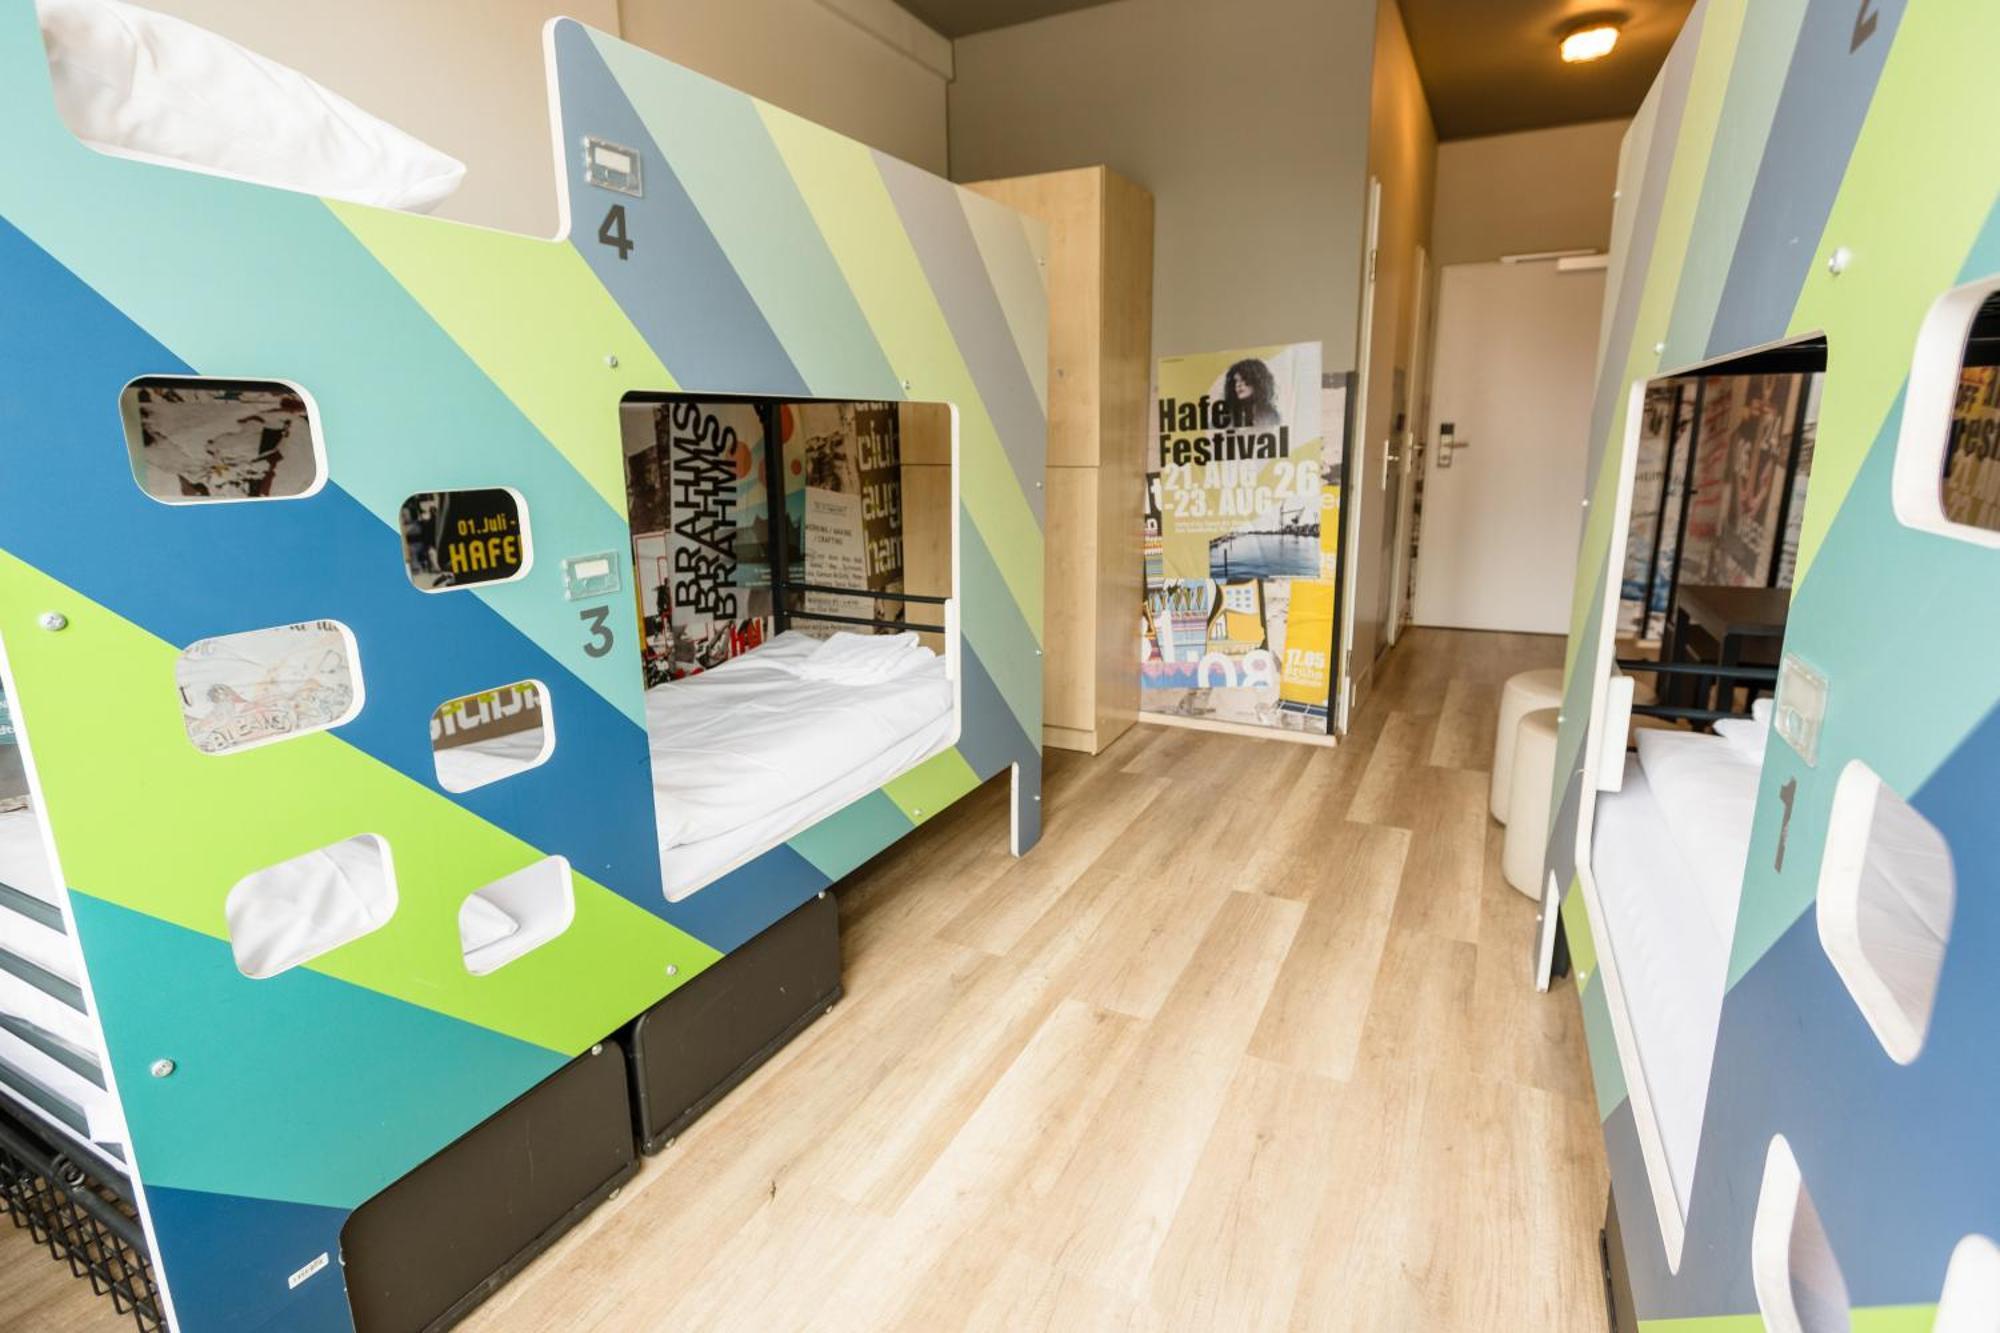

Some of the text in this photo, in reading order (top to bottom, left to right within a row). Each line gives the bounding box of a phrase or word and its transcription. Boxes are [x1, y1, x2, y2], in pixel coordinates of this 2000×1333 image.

[598, 204, 634, 260] 4
[1158, 395, 1254, 433] Hafen
[1159, 426, 1289, 468] Festival
[1203, 460, 1258, 489] AUG
[673, 401, 701, 608] BRAHMS
[693, 414, 720, 614] BRAHMS
[712, 426, 737, 620] BRAHMS
[448, 534, 522, 574] HAFE
[580, 605, 614, 658] 3
[1779, 776, 1797, 874] 1
